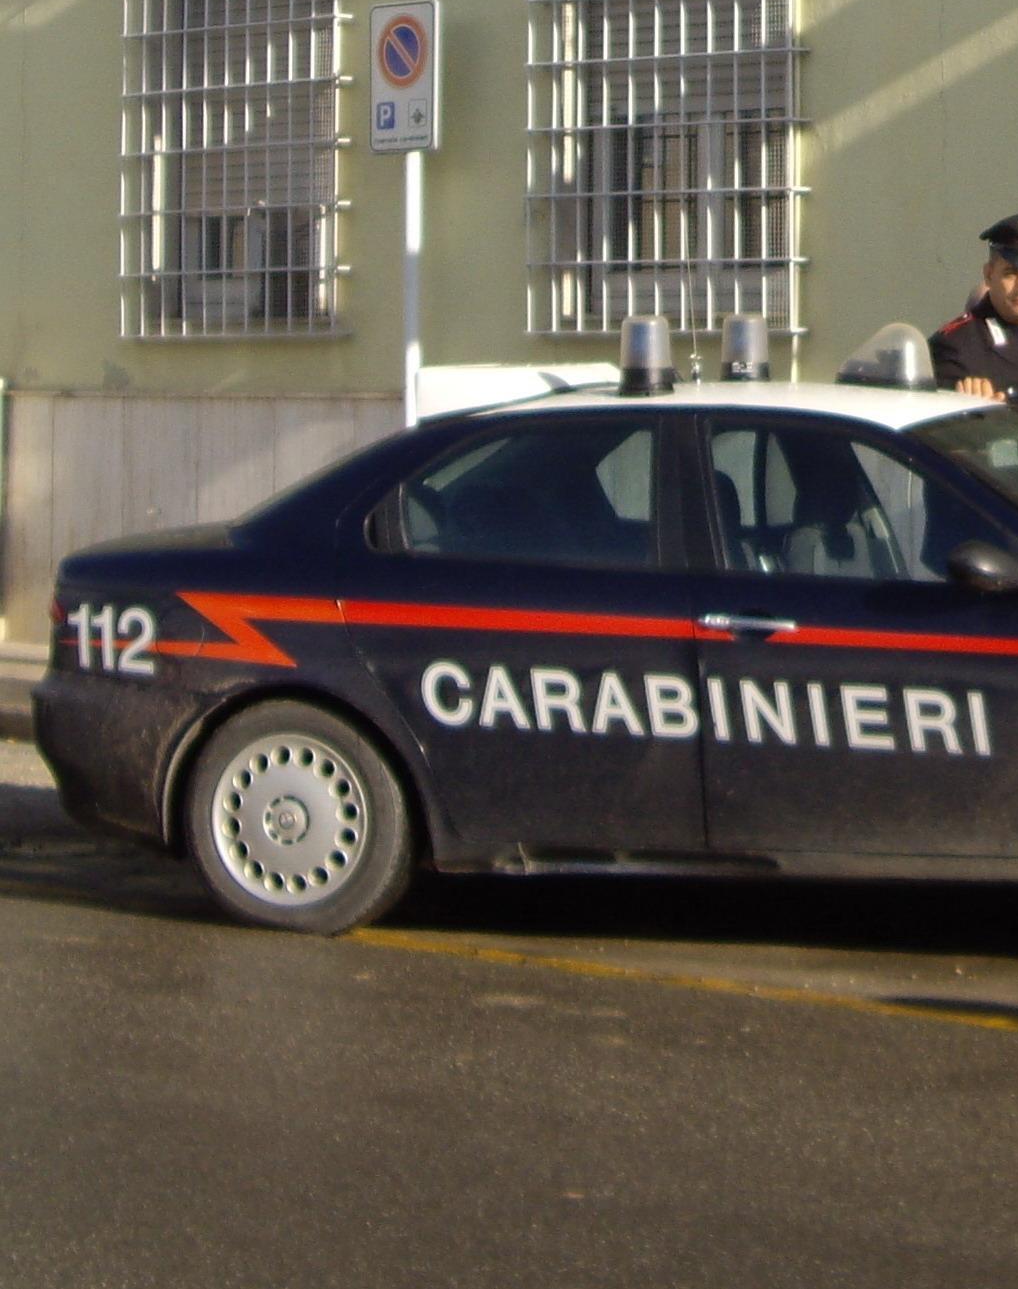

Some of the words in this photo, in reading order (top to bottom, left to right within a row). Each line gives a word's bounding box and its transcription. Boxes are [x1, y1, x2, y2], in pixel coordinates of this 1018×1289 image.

[379, 105, 393, 127] P
[67, 603, 154, 675] 112
[421, 660, 993, 758] CARABINIERI
